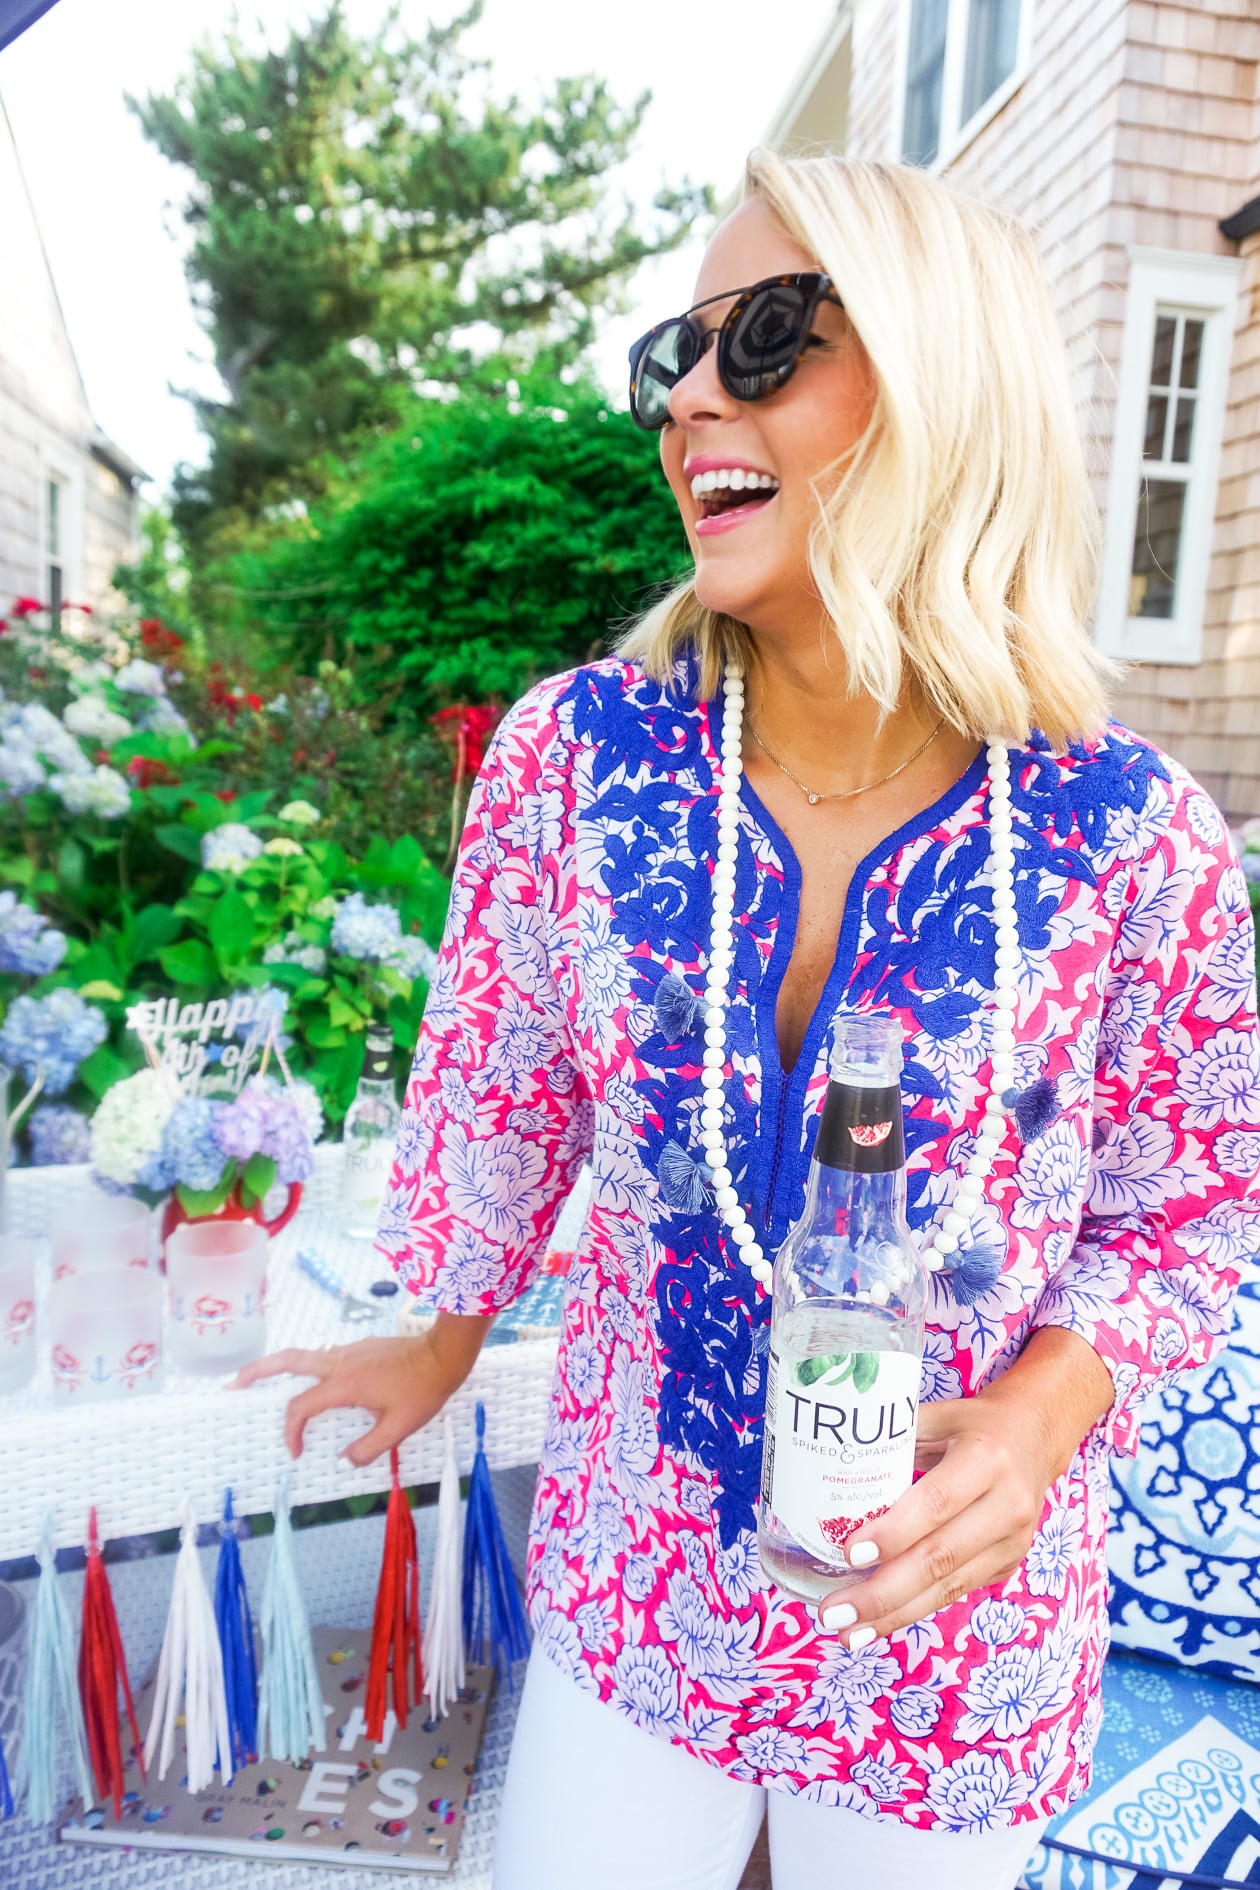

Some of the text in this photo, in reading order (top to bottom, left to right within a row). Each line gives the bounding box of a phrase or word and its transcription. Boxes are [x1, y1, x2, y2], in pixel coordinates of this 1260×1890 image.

[136, 997, 272, 1043] Happy
[344, 1151, 391, 1172] TRUL
[785, 1389, 920, 1445] TRULY
[791, 1436, 837, 1457] SPIKED
[839, 1443, 856, 1465] &
[822, 1471, 893, 1485] POMEGRANATE
[830, 1491, 844, 1501] 5%
[296, 1761, 422, 1819] ES
